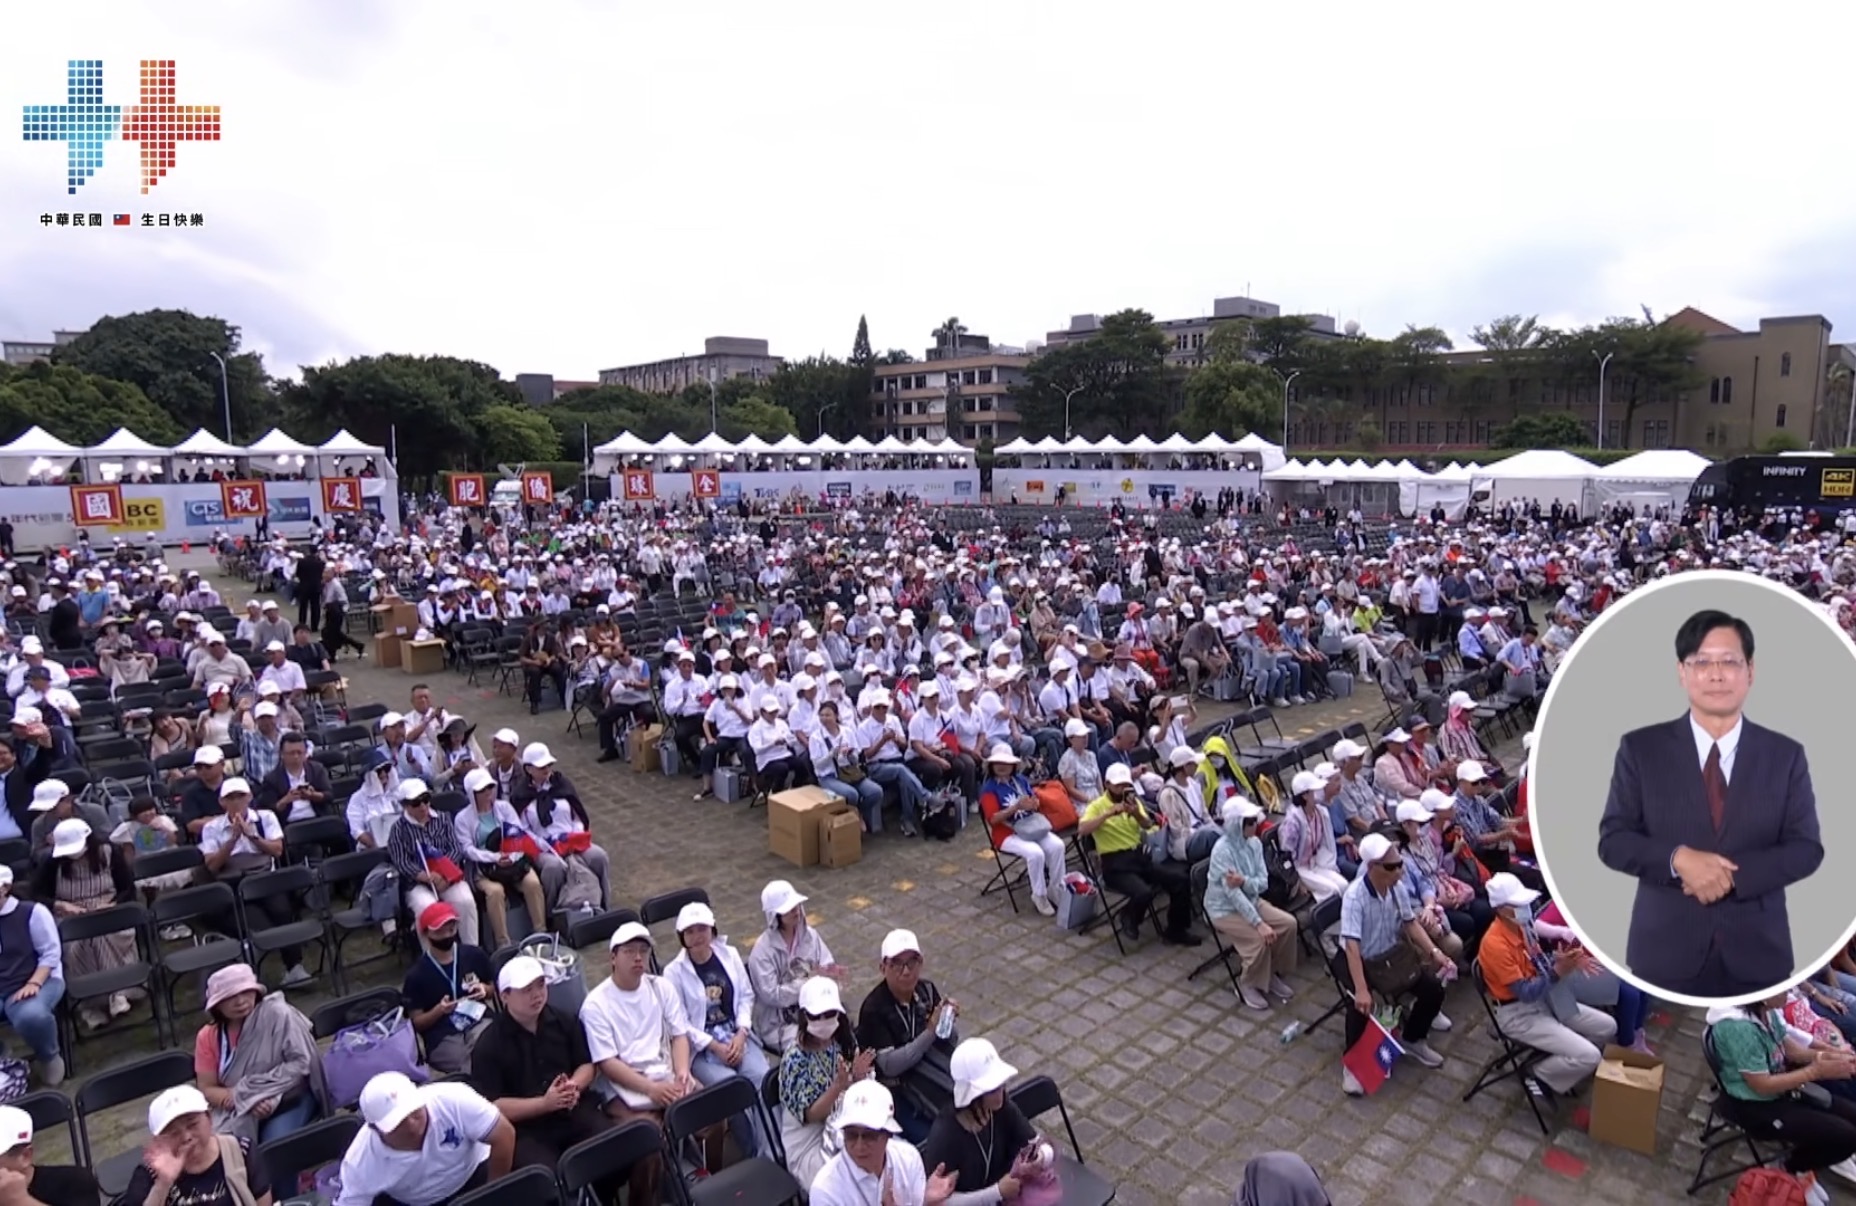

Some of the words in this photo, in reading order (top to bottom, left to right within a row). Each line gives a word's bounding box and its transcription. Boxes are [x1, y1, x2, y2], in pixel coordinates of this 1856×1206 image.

[1763, 466, 1806, 477] INFINITY
[698, 475, 715, 493] 全
[231, 487, 260, 512] 祝
[331, 483, 356, 508] 慶
[85, 492, 112, 519] 國
[127, 503, 157, 517] BC
[191, 501, 220, 515] CTS
